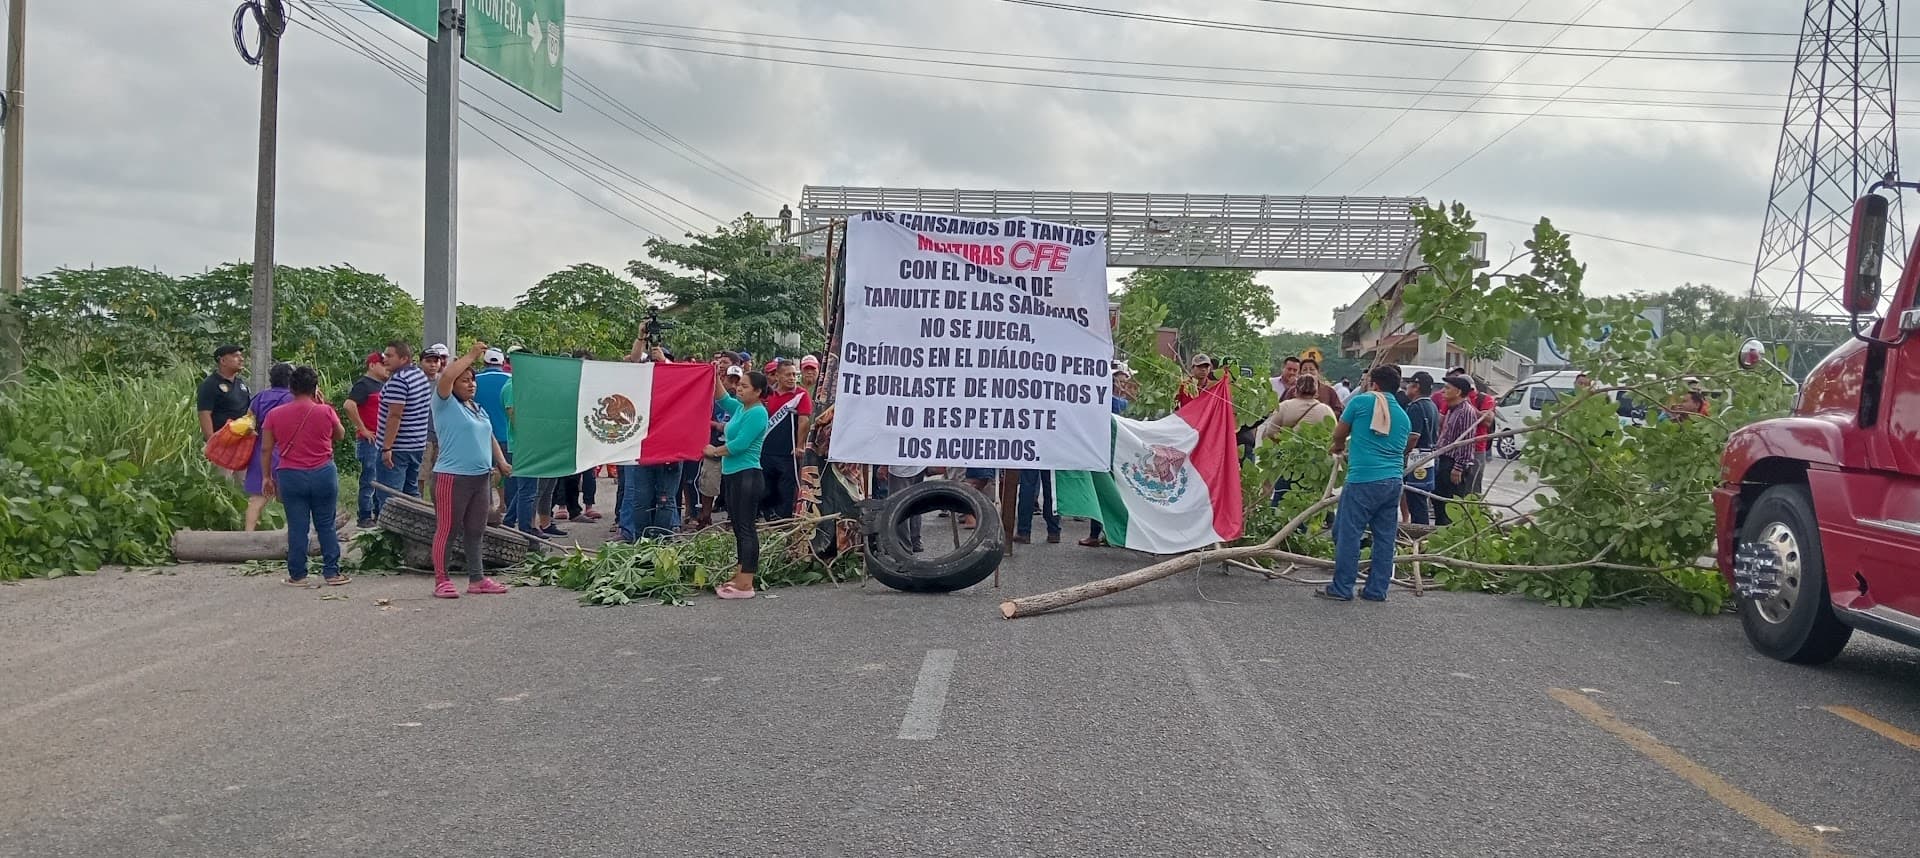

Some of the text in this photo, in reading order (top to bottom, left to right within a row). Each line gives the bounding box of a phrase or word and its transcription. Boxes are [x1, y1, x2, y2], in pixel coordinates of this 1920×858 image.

[900, 213, 1000, 235] CANSAMOS
[1004, 221, 1026, 237] DE
[1031, 222, 1095, 246] TANTAS
[1009, 240, 1071, 272] CFE
[900, 260, 937, 279] CON
[942, 261, 959, 280] EL
[1032, 277, 1053, 297] DE
[865, 286, 940, 308] TAMULTE
[945, 290, 966, 309] DE
[972, 292, 1004, 312] LAS
[921, 318, 1035, 344] NO SE JUEGA,
[845, 342, 1107, 377] CREÍMOS EN EL DIÁLOGO PERO
[843, 373, 1107, 404] TE BURLASTE DE NOSOTROS Y
[887, 406, 1056, 430] NO RESPETASTE
[899, 437, 1040, 461] LOS ACUERDOS.
